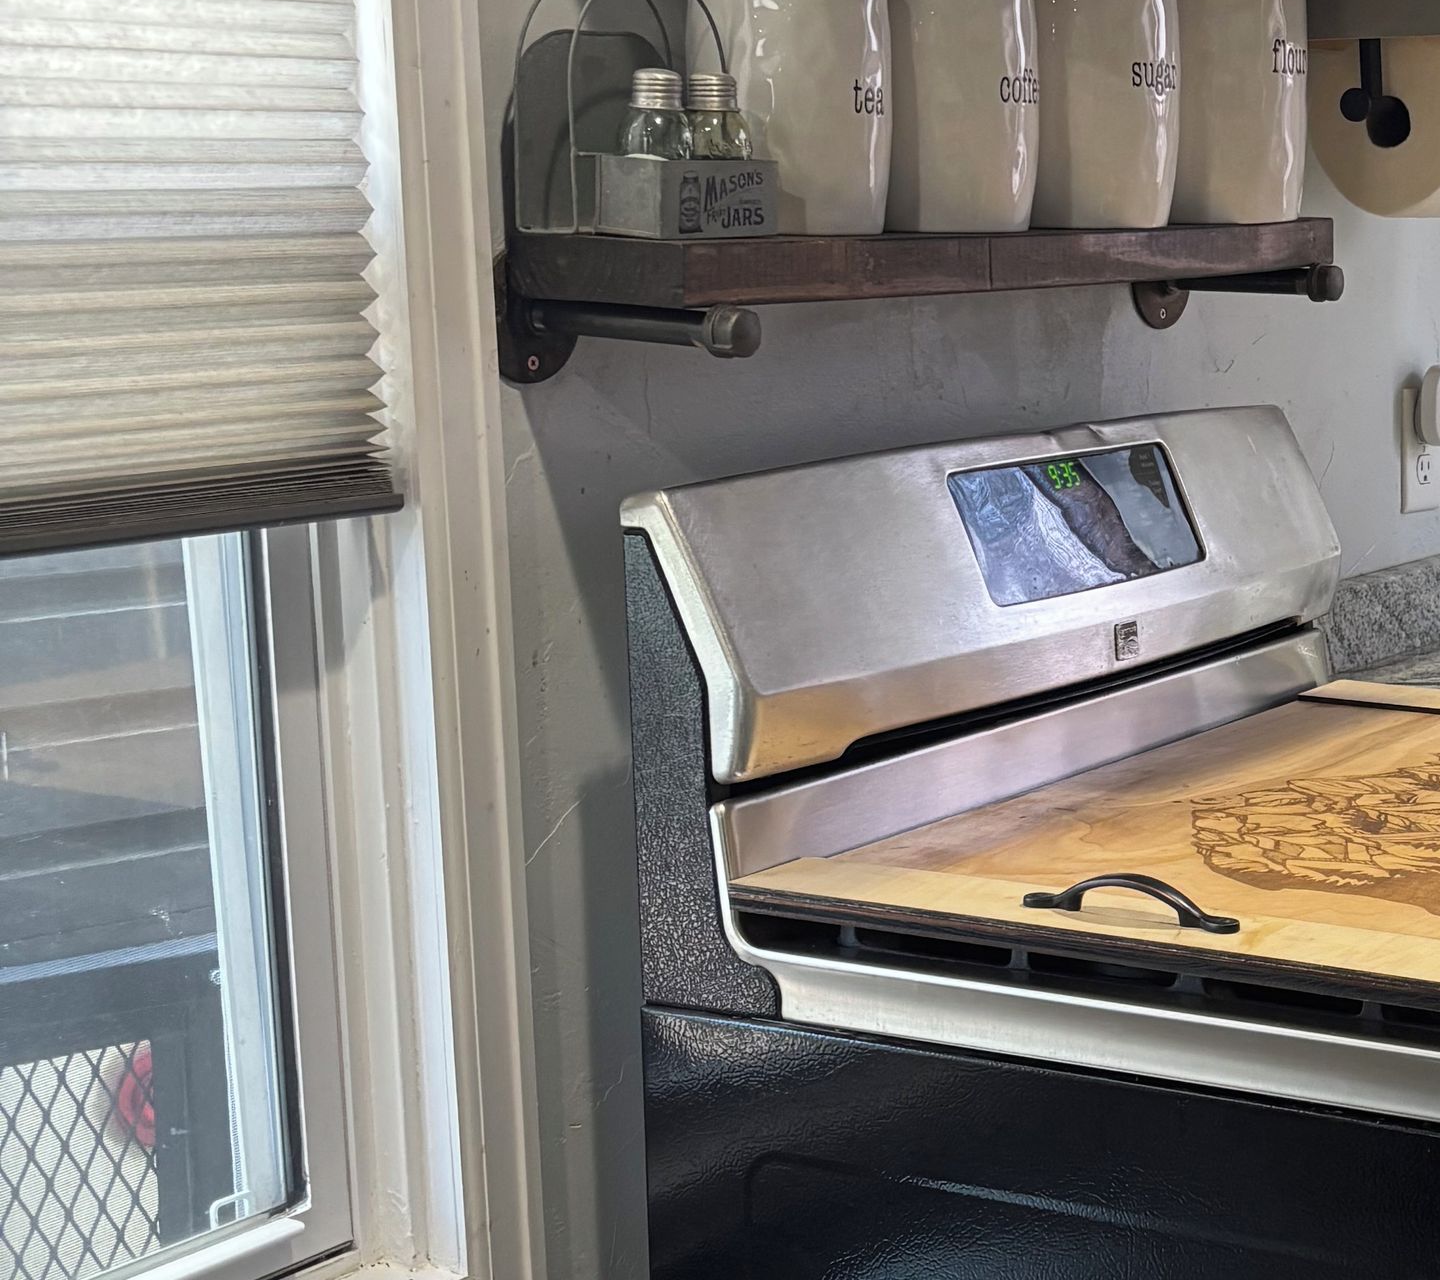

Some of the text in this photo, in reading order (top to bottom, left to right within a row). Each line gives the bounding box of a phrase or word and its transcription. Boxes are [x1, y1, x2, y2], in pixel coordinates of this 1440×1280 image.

[1272, 38, 1306, 75] flour
[1000, 68, 1040, 104] coffe
[1131, 57, 1177, 97] sugar
[853, 79, 884, 116] tea
[704, 169, 763, 213] MASON'S
[721, 206, 765, 229] JARS
[1048, 462, 1080, 488] 9:35
